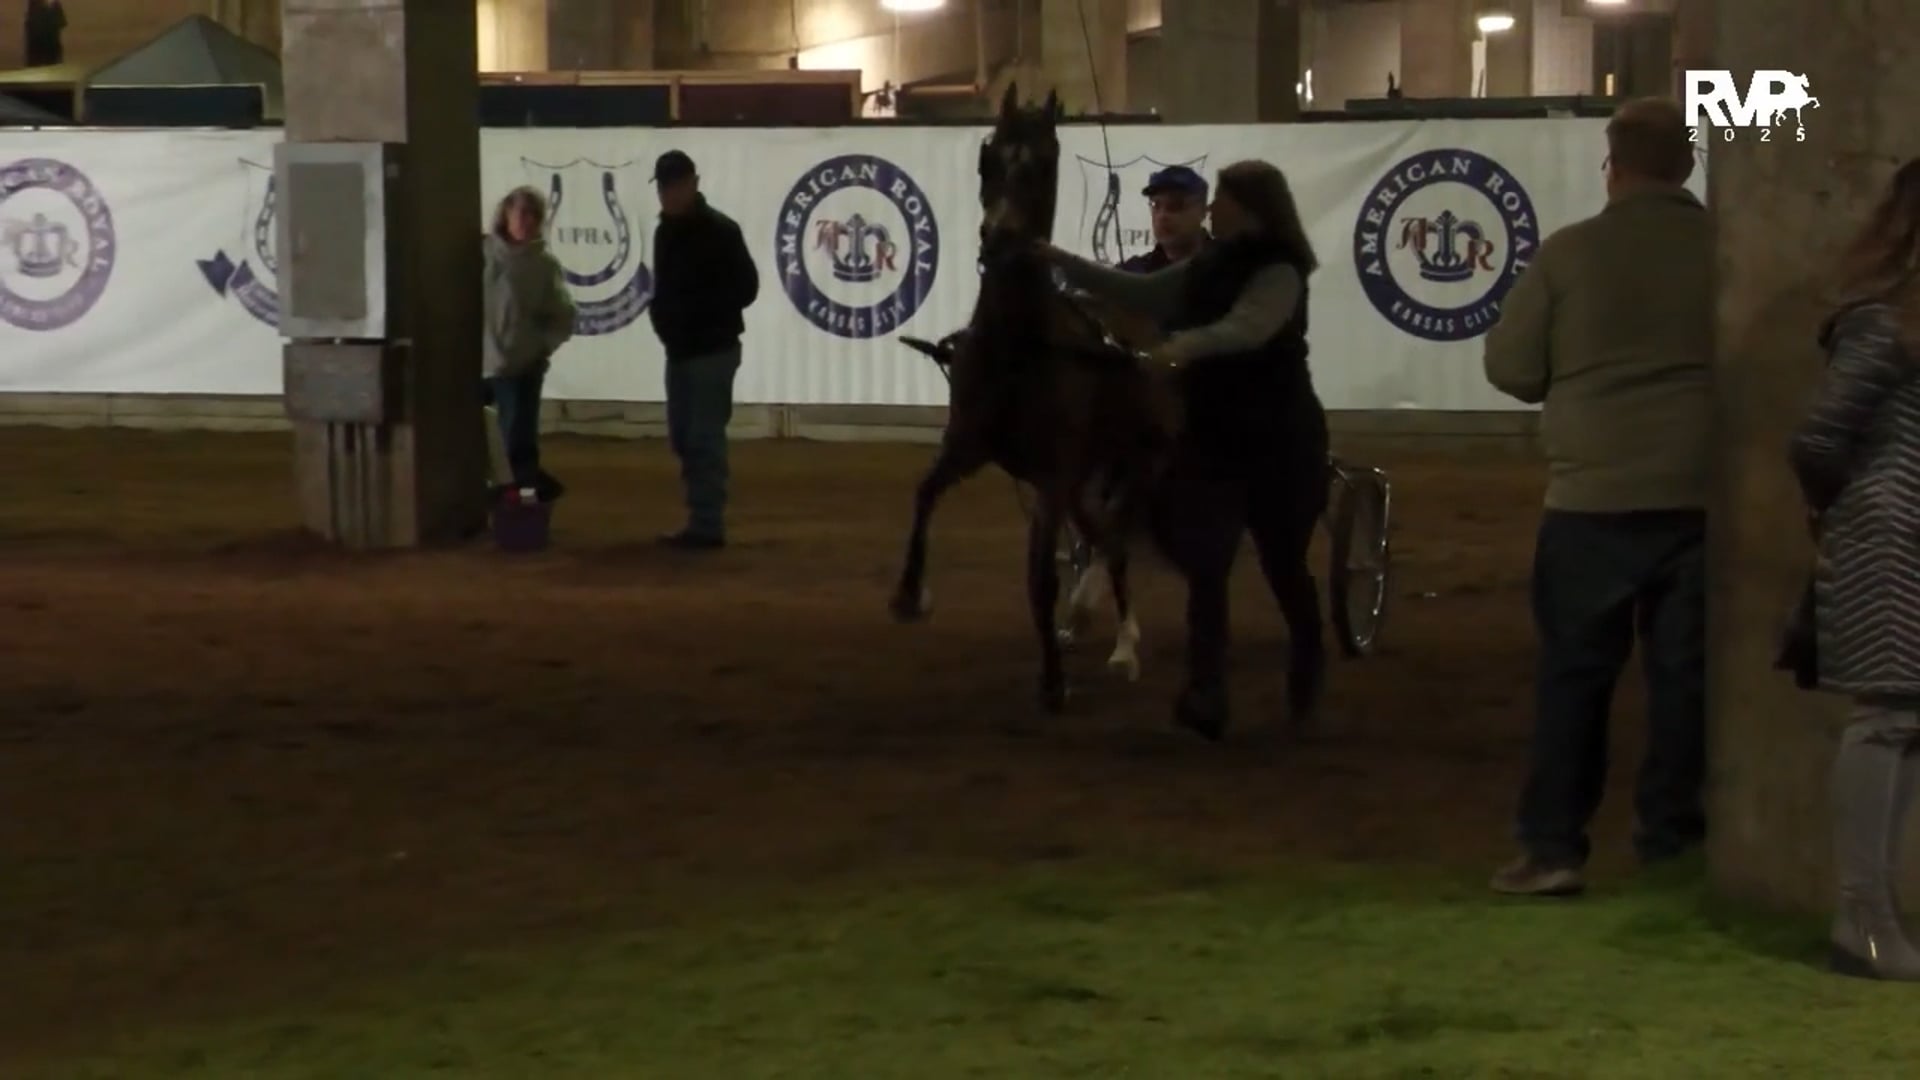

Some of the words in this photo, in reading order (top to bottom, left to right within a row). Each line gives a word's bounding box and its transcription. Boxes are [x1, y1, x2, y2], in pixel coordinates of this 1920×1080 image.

[557, 227, 613, 246] UPHA
[781, 162, 879, 276] AMERICAN
[890, 178, 933, 276] ROYAL
[1361, 157, 1472, 277] AMERICAN
[1486, 171, 1532, 275] ROYAL
[1391, 300, 1455, 333] KANSAS
